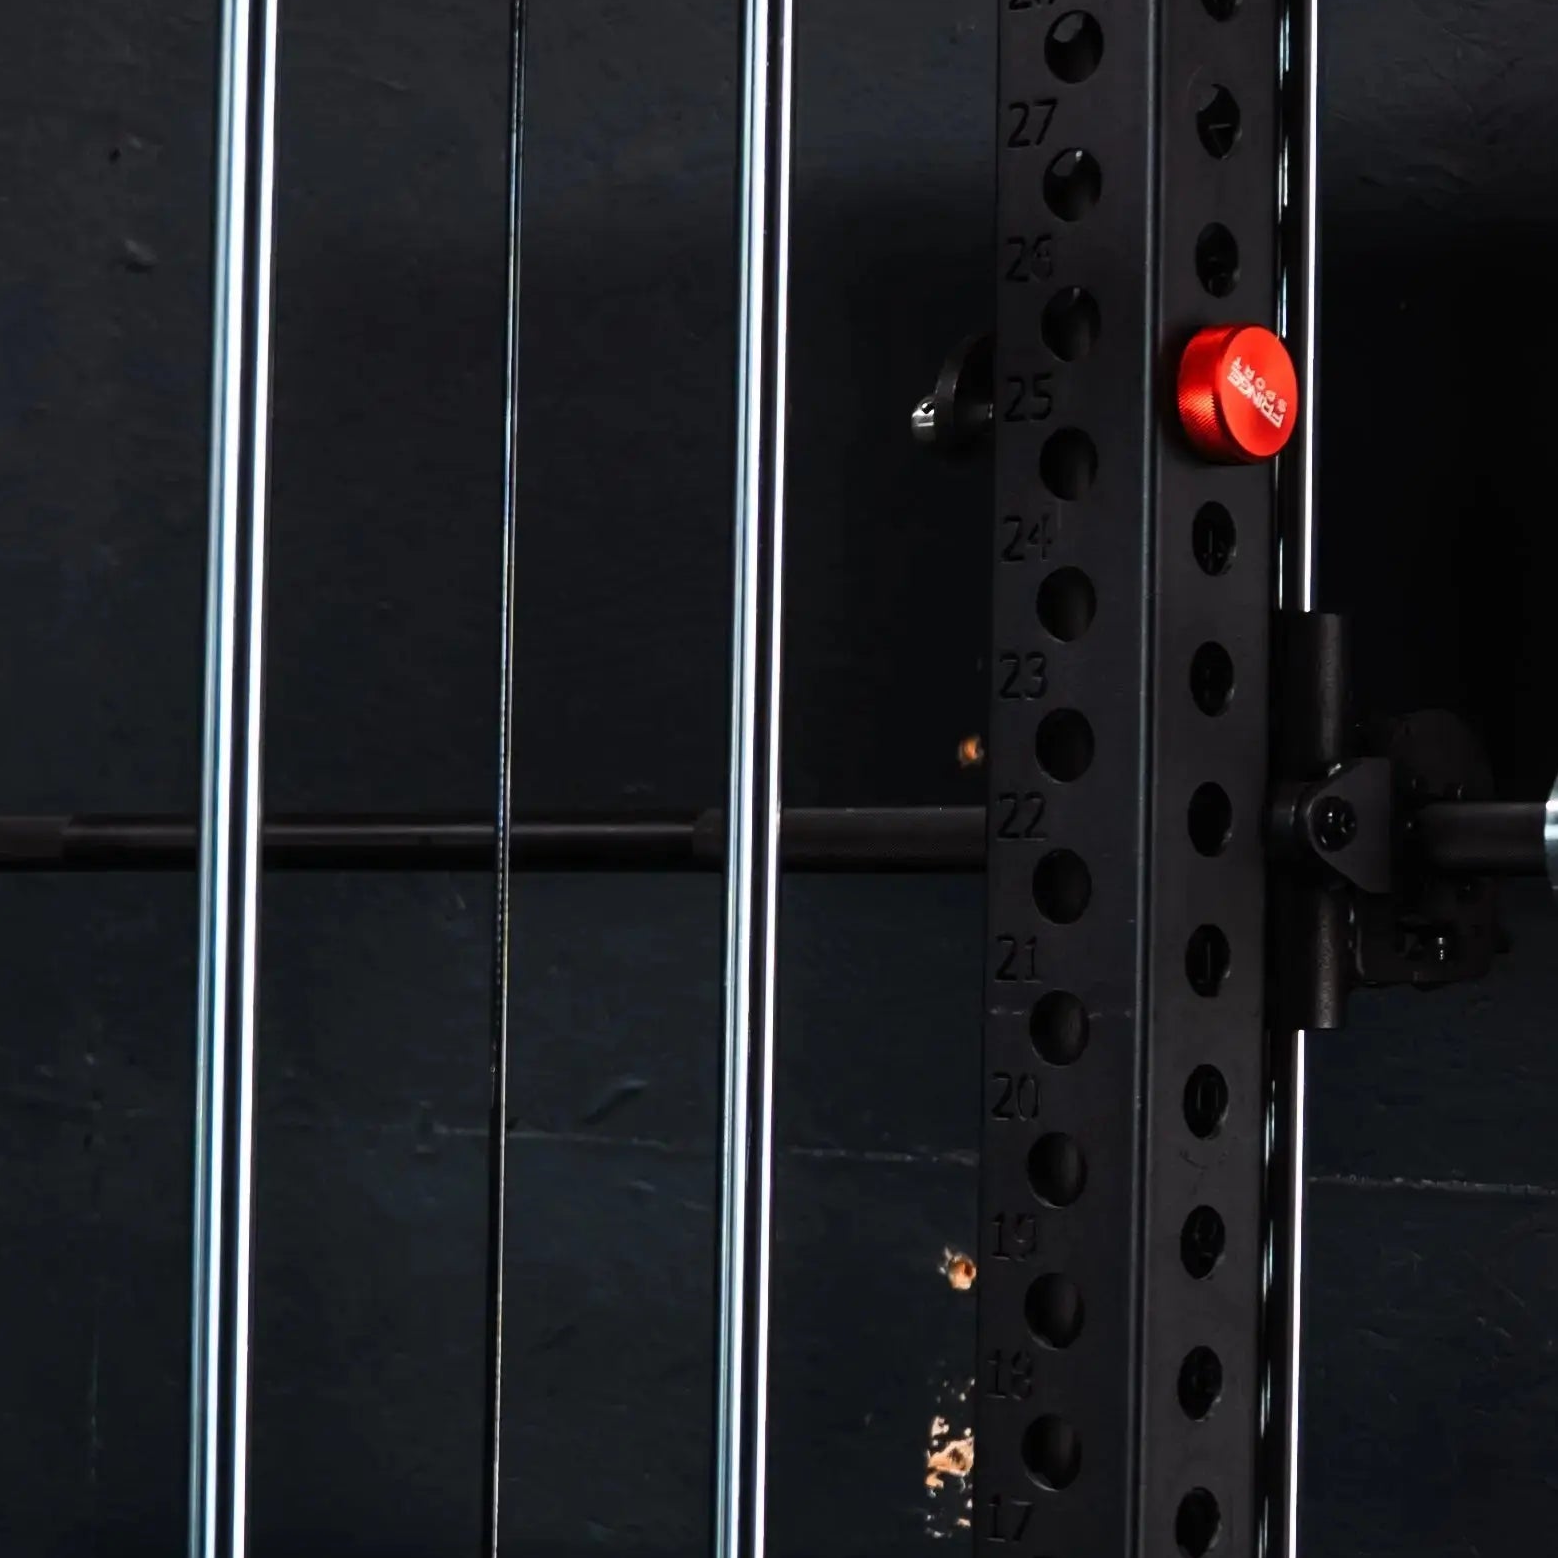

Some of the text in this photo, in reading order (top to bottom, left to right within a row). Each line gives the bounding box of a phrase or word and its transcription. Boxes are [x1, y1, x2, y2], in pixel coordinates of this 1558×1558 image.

[1007, 100, 1057, 148] 27
[1004, 374, 1052, 422] 25
[999, 653, 1047, 699] 23
[997, 792, 1046, 840] 22
[995, 936, 1041, 982] 21
[990, 1073, 1040, 1123] 20
